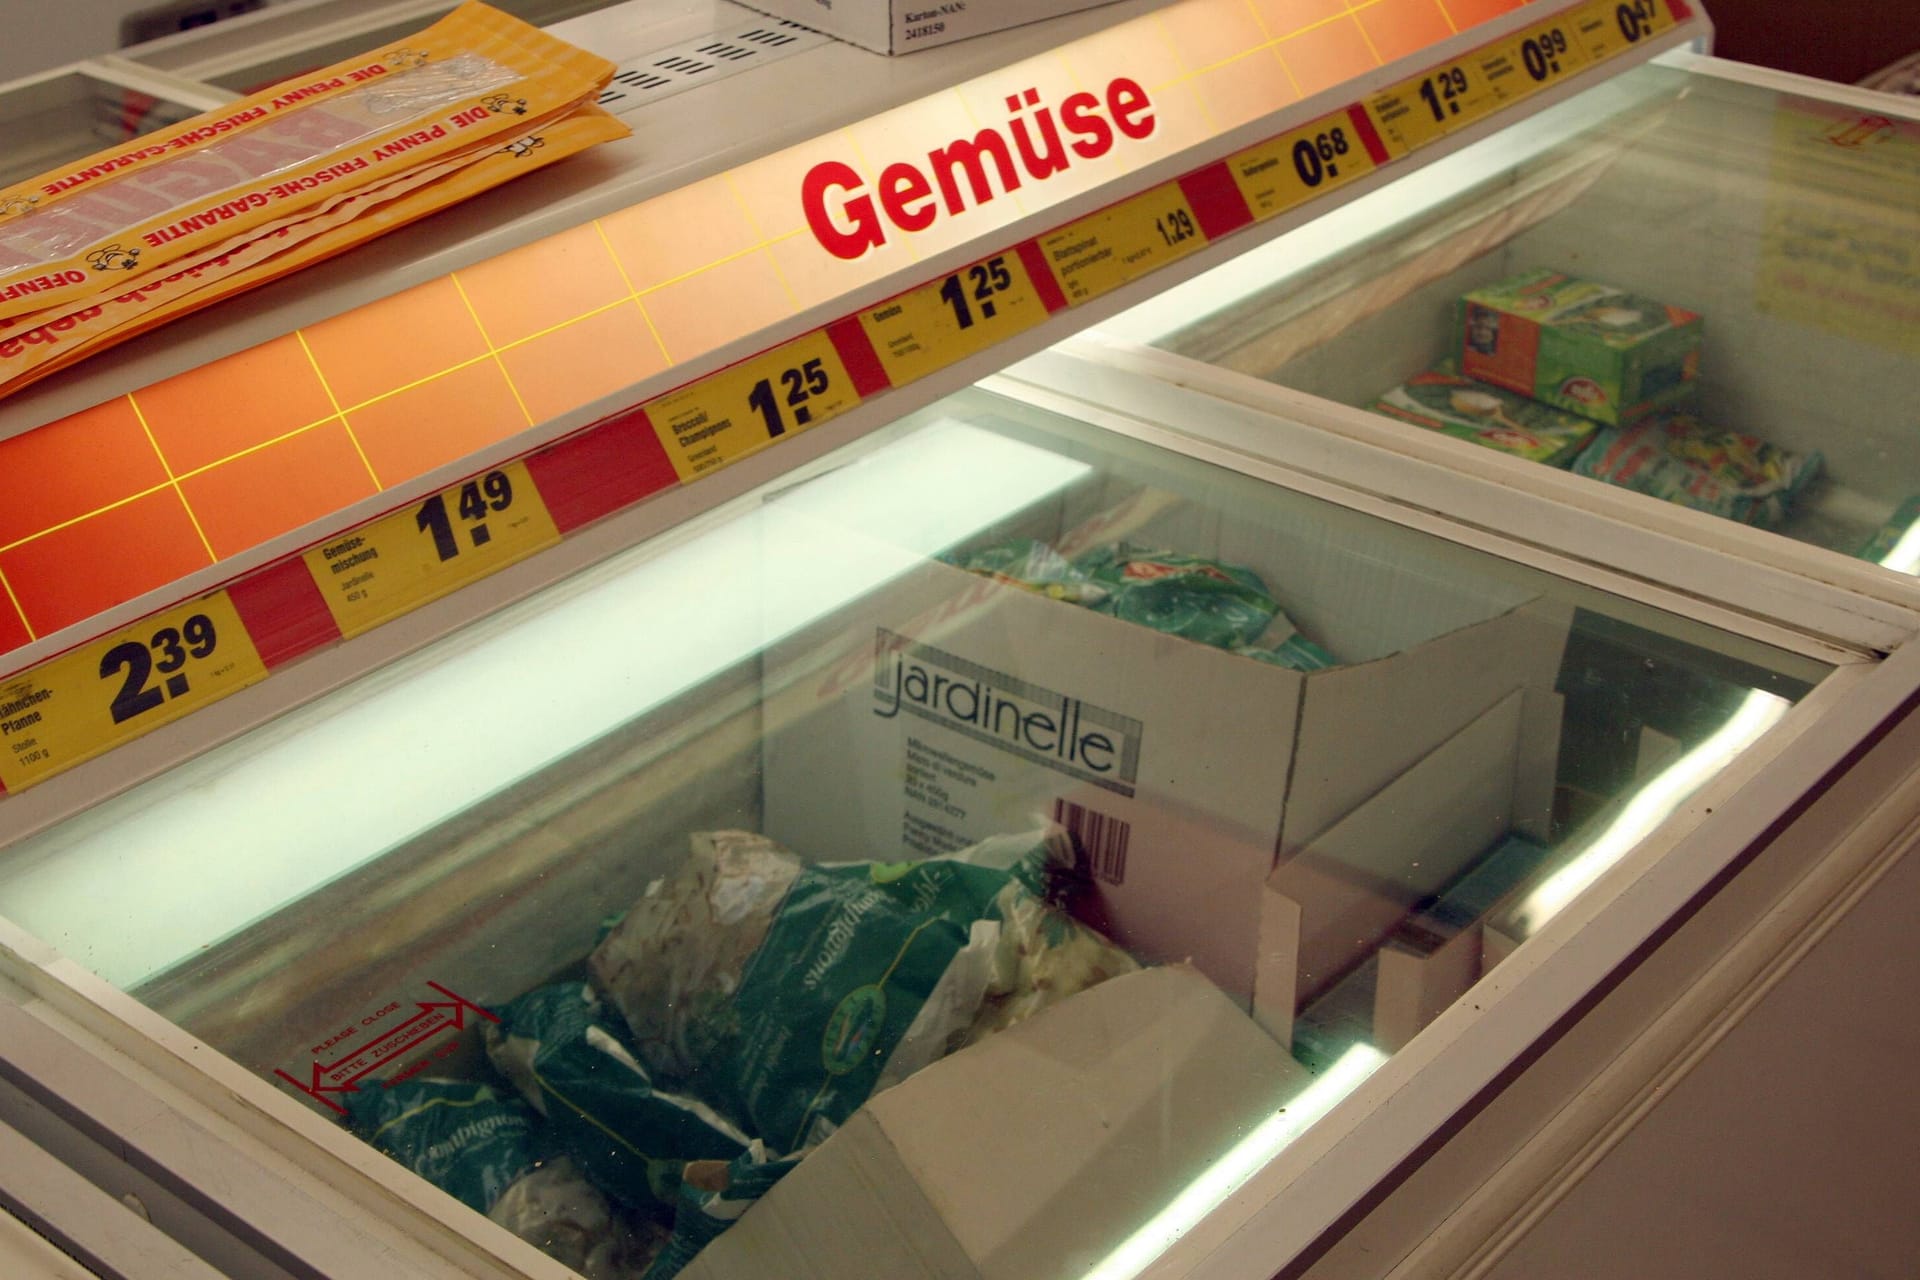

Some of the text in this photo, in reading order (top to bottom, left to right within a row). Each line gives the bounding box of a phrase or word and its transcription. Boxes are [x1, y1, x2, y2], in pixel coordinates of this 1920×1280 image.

[1520, 28, 1568, 82] 0.99
[42, 63, 388, 197] DIE PENNY FRISCHE-GARANTIE
[1418, 66, 1468, 123] 1.29
[141, 105, 490, 249] DIE PENNY FRISCHE-GARANTIE
[800, 77, 1158, 262] Gemüse
[1291, 126, 1350, 187] 0.68
[1156, 210, 1196, 247] 1.29
[940, 256, 1012, 331] 1.25
[747, 356, 830, 438] 1.25
[416, 470, 513, 563] 1.49
[99, 614, 218, 725] 2.39
[873, 654, 1115, 773] jardinelle
[311, 1001, 401, 1055] PLEASE CLOSE
[330, 1012, 446, 1082] BITTE ZUSCHIEBEN
